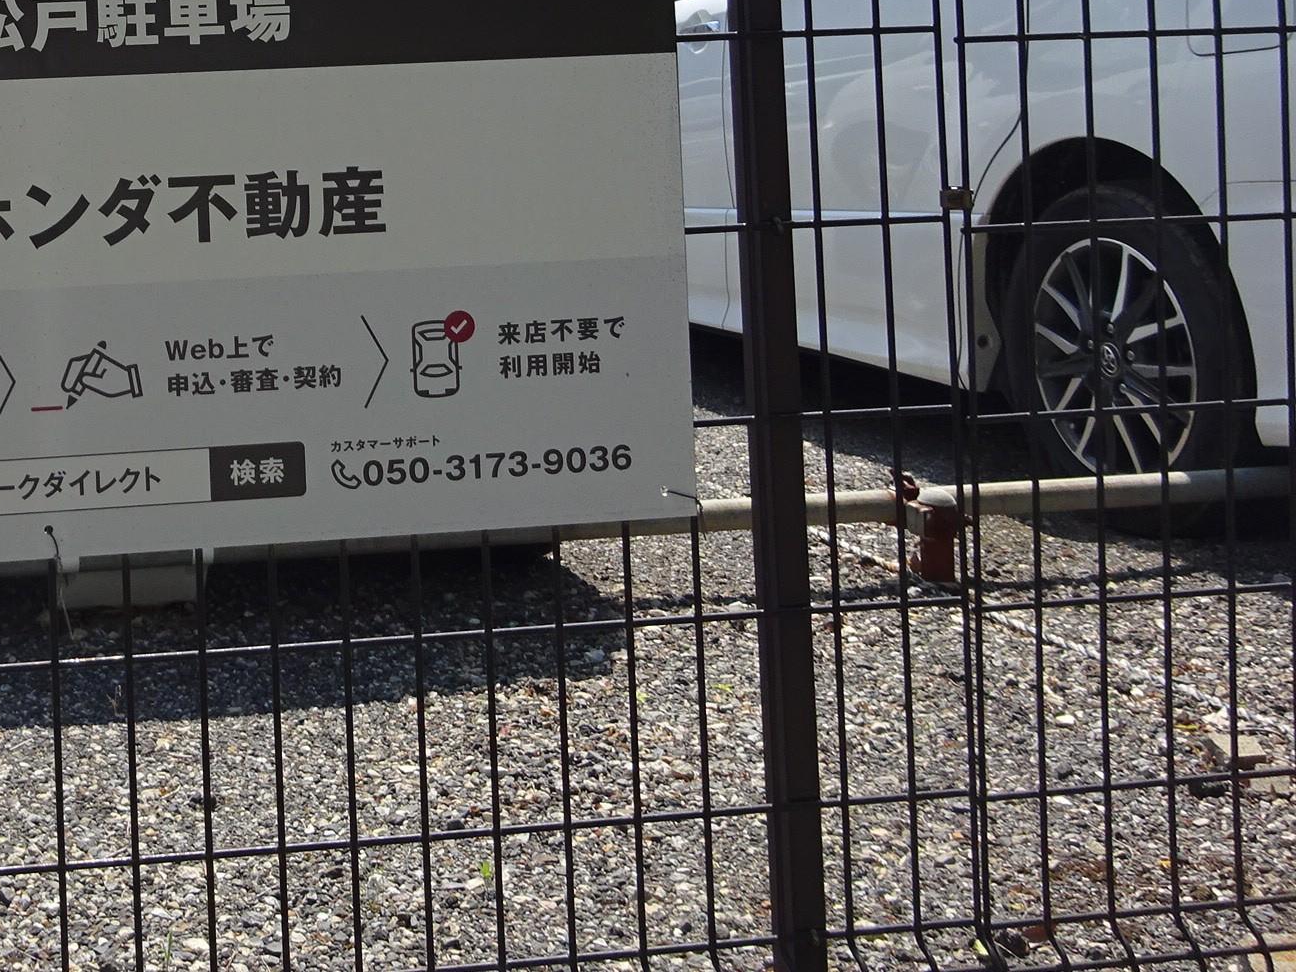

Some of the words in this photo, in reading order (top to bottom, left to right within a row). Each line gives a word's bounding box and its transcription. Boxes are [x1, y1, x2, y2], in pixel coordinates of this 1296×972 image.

[499, 316, 624, 345] 来店不要で
[165, 335, 273, 361] Web上で
[500, 351, 600, 378] 利用開始
[168, 365, 341, 396] 申込・審査・契約
[331, 435, 440, 452] カスタマーサポート
[230, 457, 284, 485] 検索
[362, 444, 632, 486] 050-3173-9036
